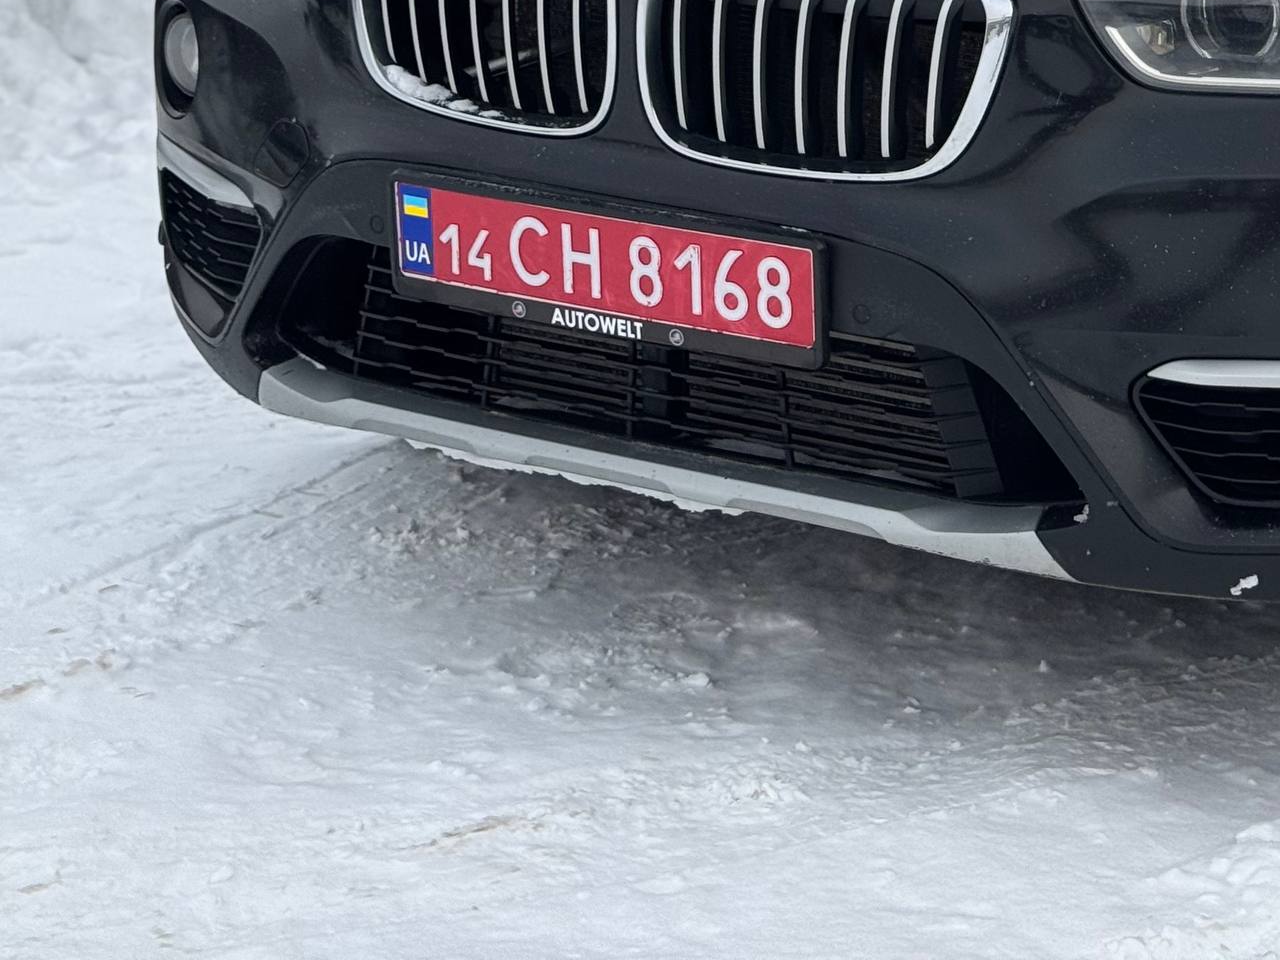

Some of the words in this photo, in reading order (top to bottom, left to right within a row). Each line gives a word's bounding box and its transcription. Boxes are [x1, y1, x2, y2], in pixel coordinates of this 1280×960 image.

[404, 239, 431, 266] UA
[439, 223, 493, 282] 14
[508, 216, 602, 300] CH
[628, 235, 793, 330] 8168
[550, 306, 644, 341] AUTOWELT
